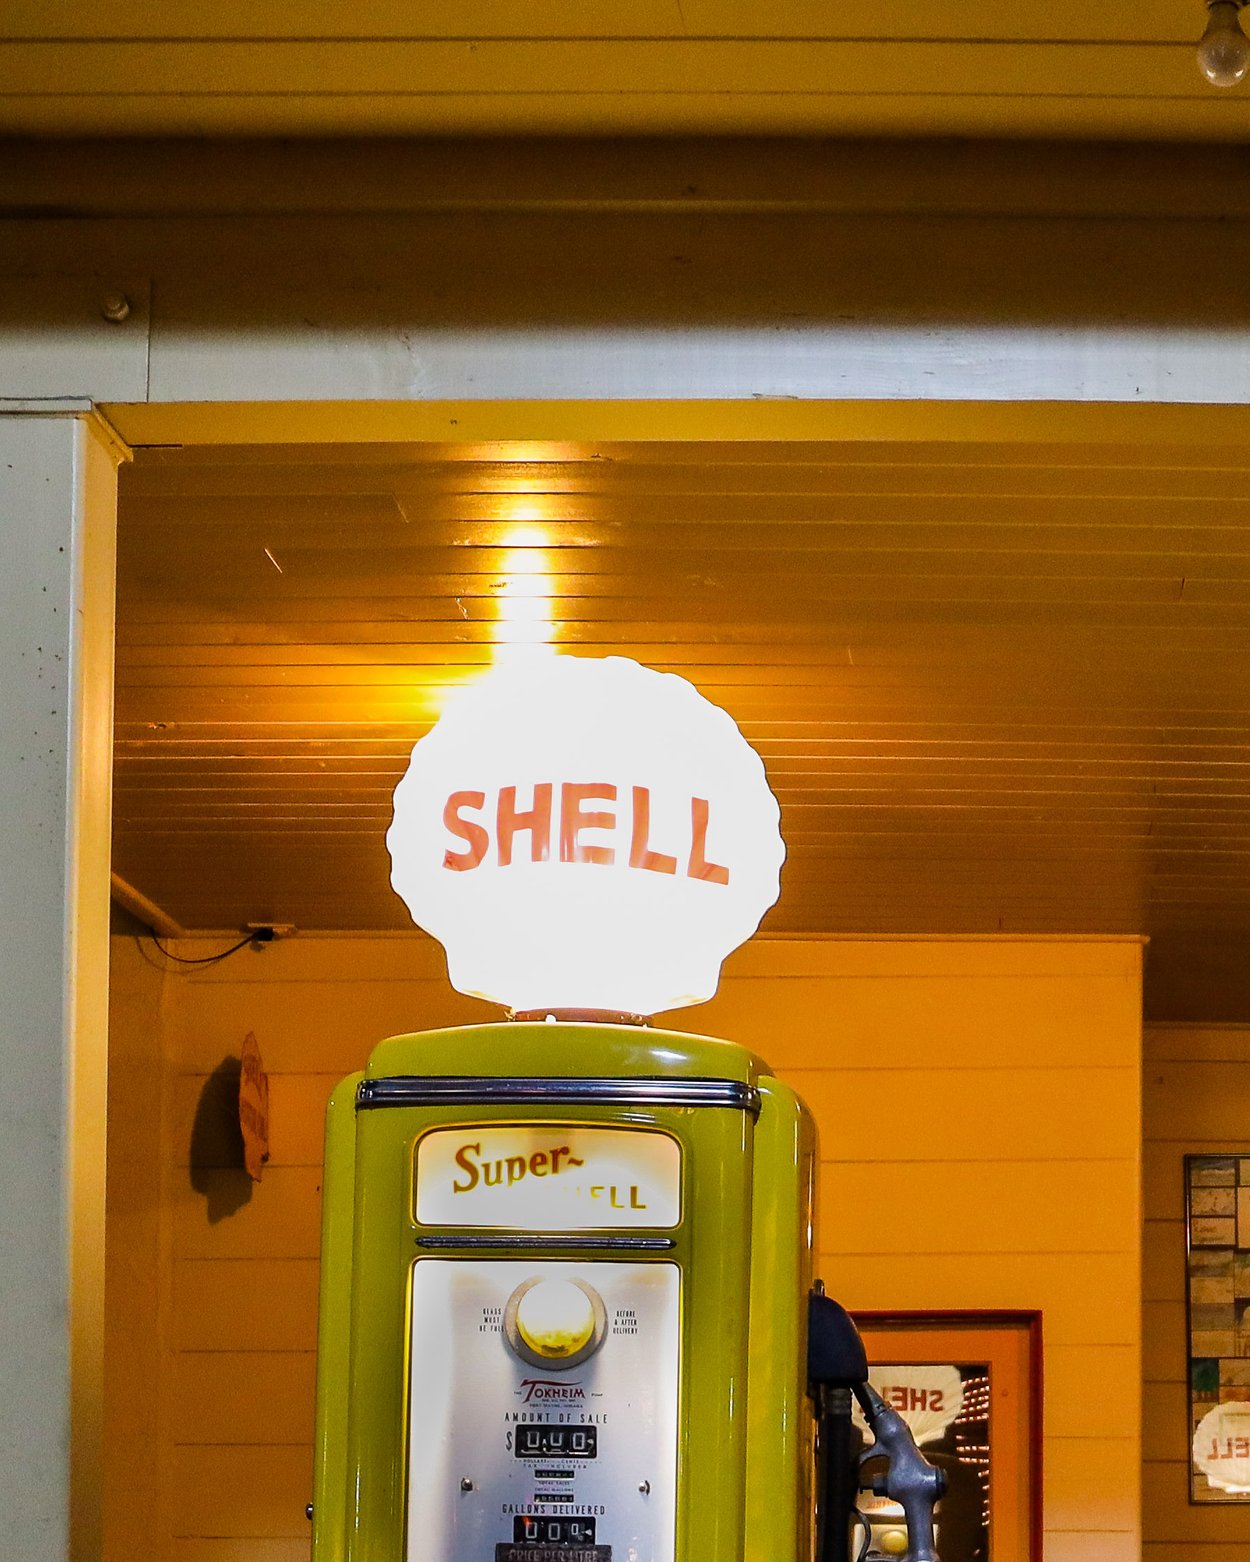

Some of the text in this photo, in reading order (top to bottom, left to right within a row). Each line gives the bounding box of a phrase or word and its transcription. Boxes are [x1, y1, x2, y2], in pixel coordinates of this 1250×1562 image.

[442, 782, 730, 886] SHELL
[580, 1185, 647, 1210] ELL
[504, 1412, 608, 1424] AMOUNT OF SALE
[505, 1430, 513, 1452] $
[502, 1503, 605, 1515] GALLONS DELIVERED
